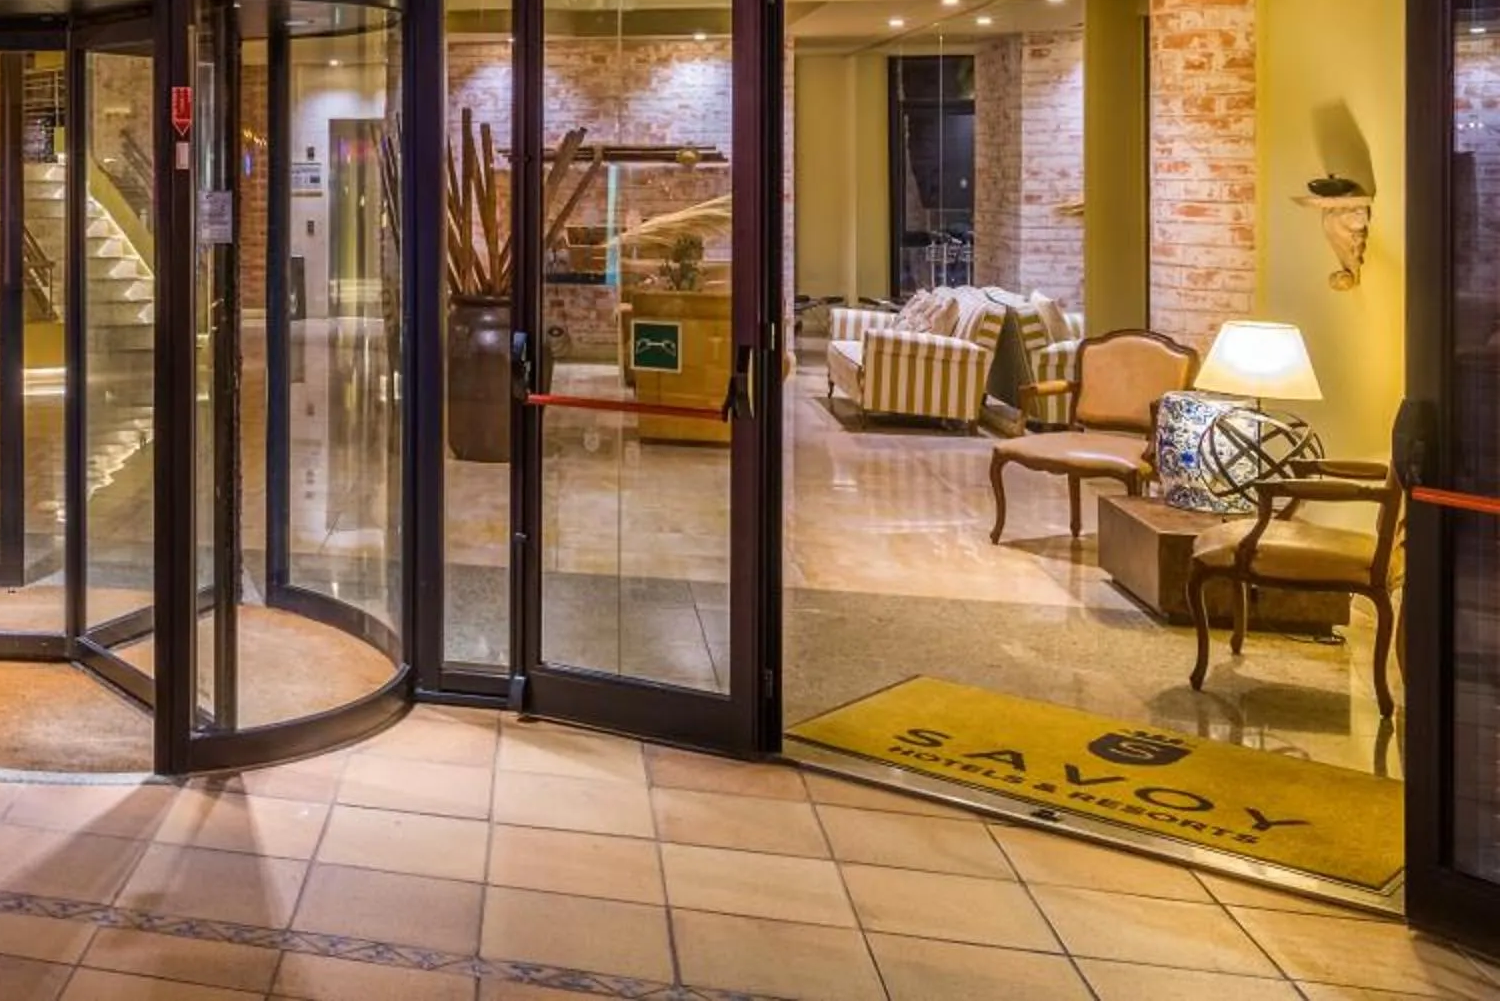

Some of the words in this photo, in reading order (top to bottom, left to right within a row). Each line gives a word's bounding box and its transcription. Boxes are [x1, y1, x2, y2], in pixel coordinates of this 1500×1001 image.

[888, 745, 1028, 785] HOTELS
[1068, 791, 1260, 845] RESORTS
[893, 728, 1313, 831] SAVOY
